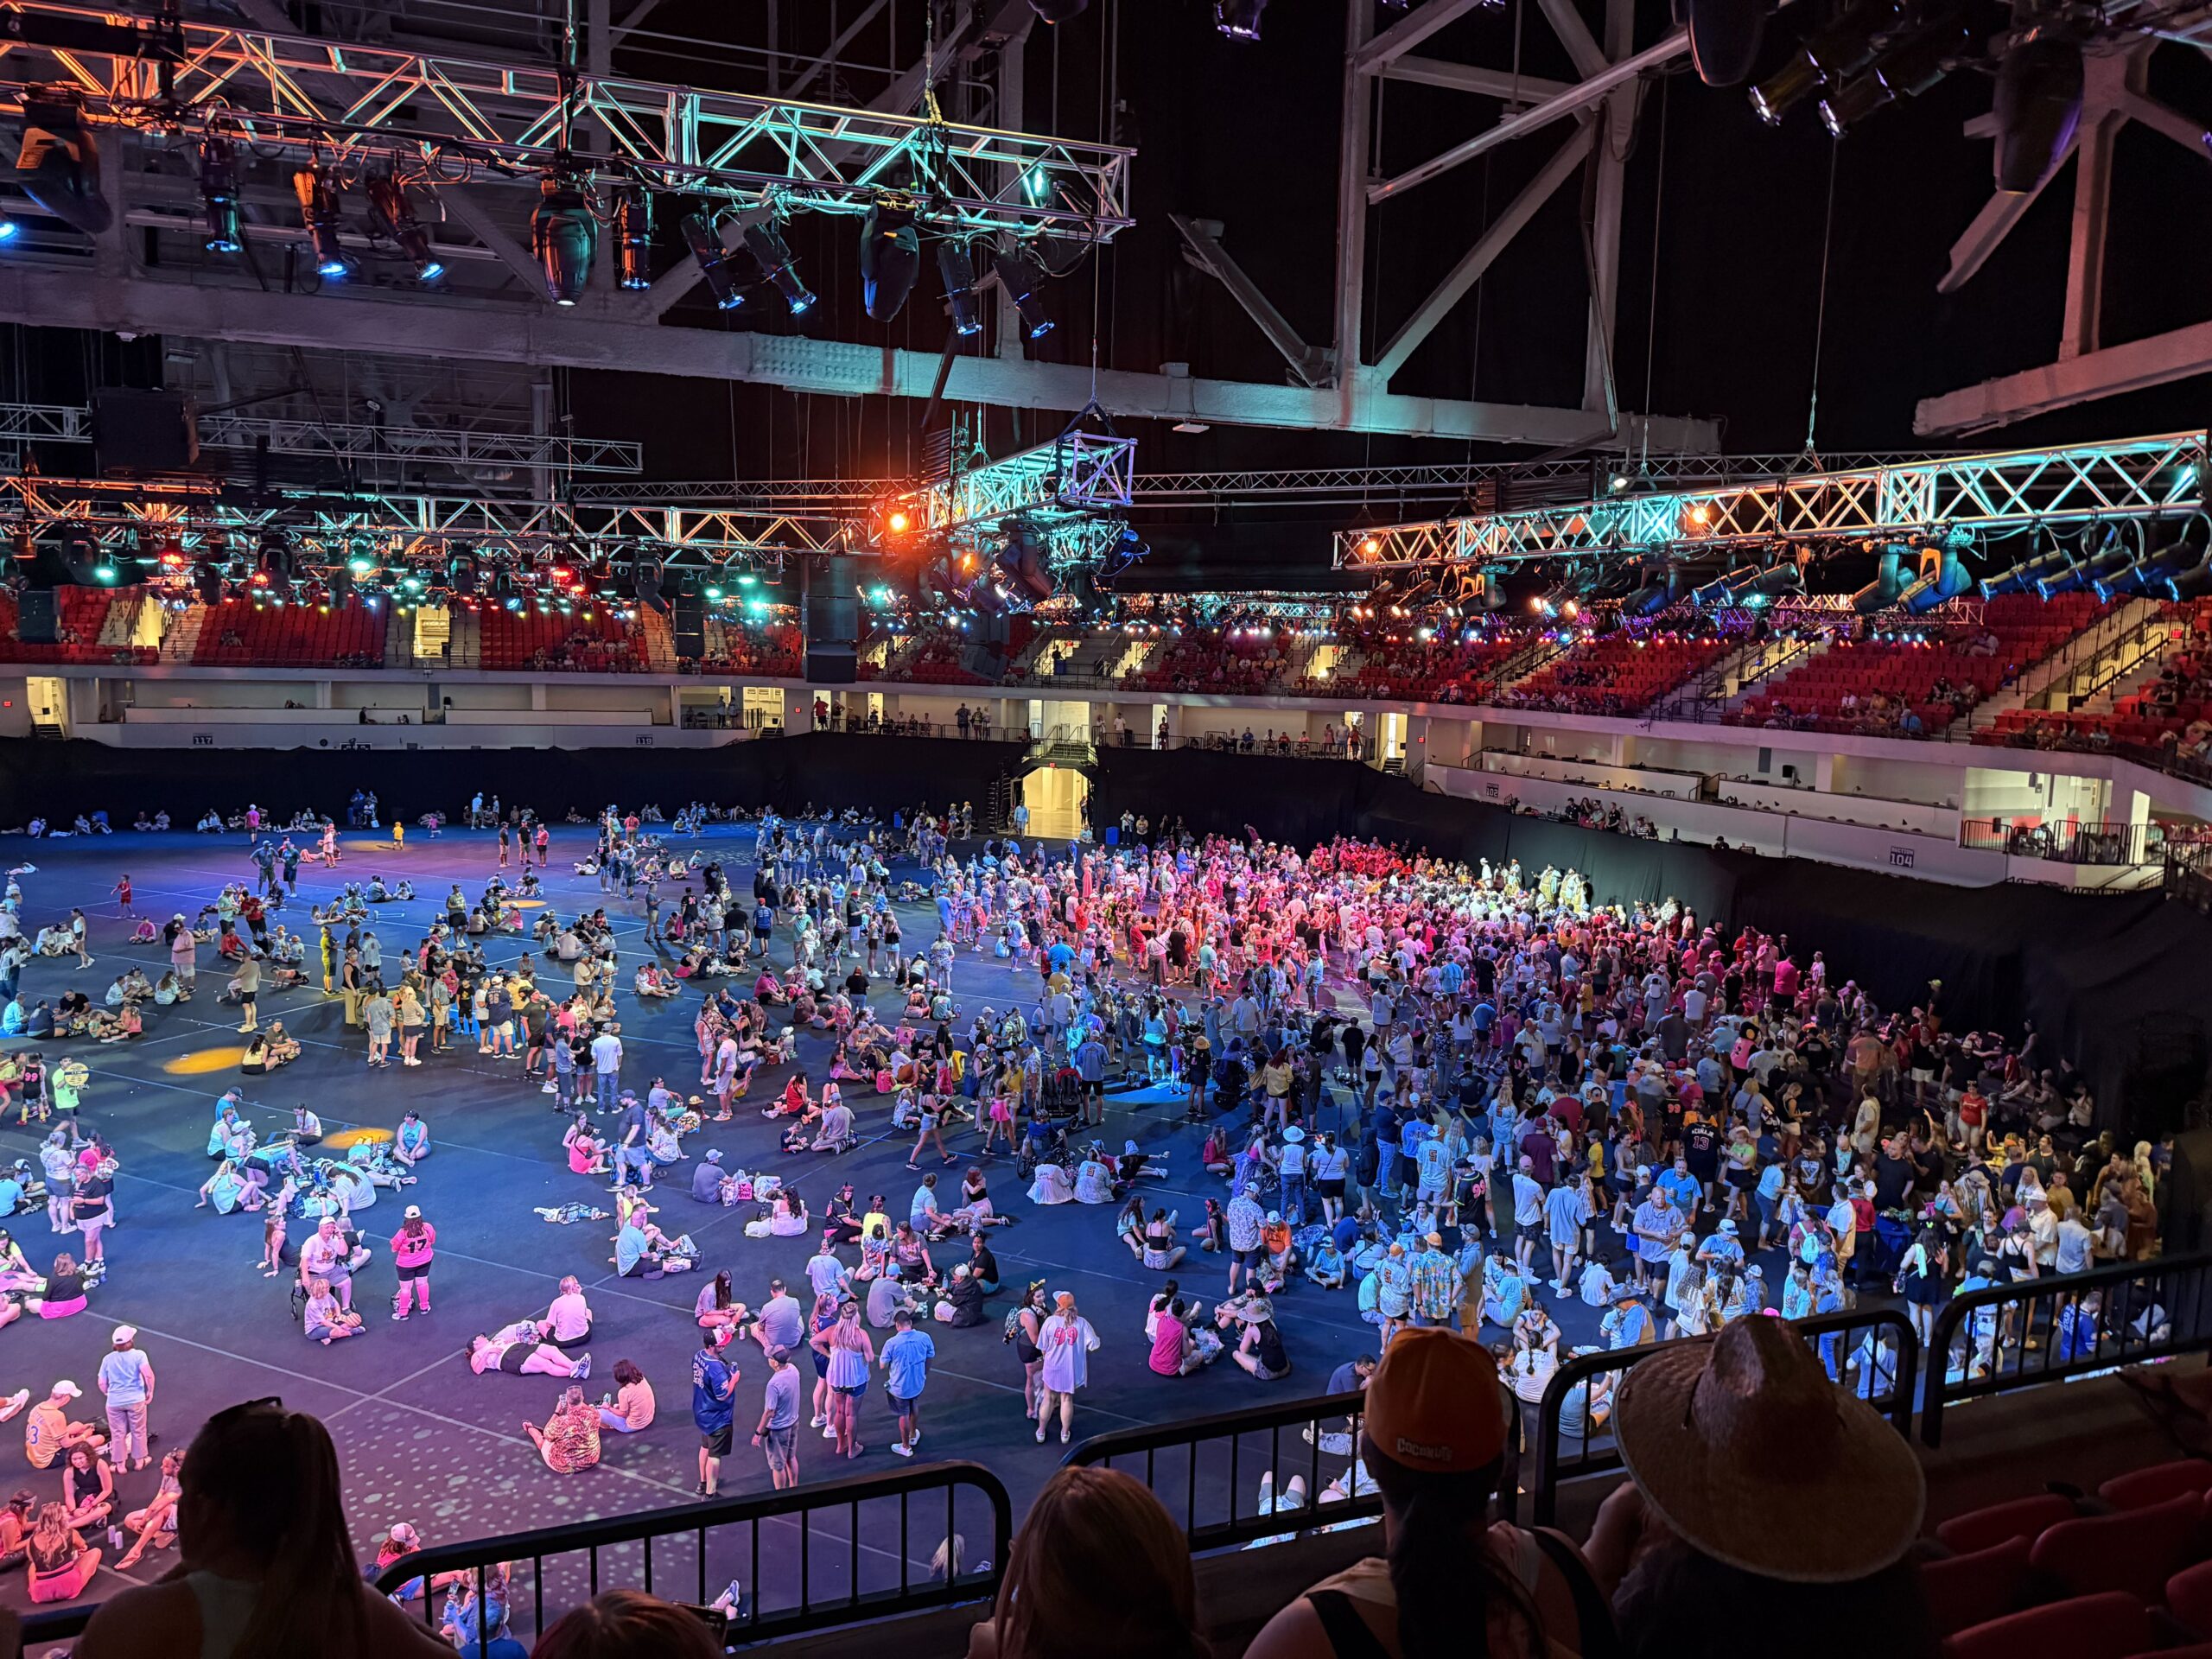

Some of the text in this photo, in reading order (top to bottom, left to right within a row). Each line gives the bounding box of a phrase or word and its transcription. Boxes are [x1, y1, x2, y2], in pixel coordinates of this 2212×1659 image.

[194, 736, 212, 745] 117
[1486, 787, 1498, 797] 102
[1890, 853, 1912, 868] 104
[24, 1073, 38, 1082] 99
[1693, 1135, 1709, 1151] 13
[1471, 1178, 1486, 1198] 99
[408, 1239, 427, 1253] 17
[1054, 1327, 1078, 1346] 99
